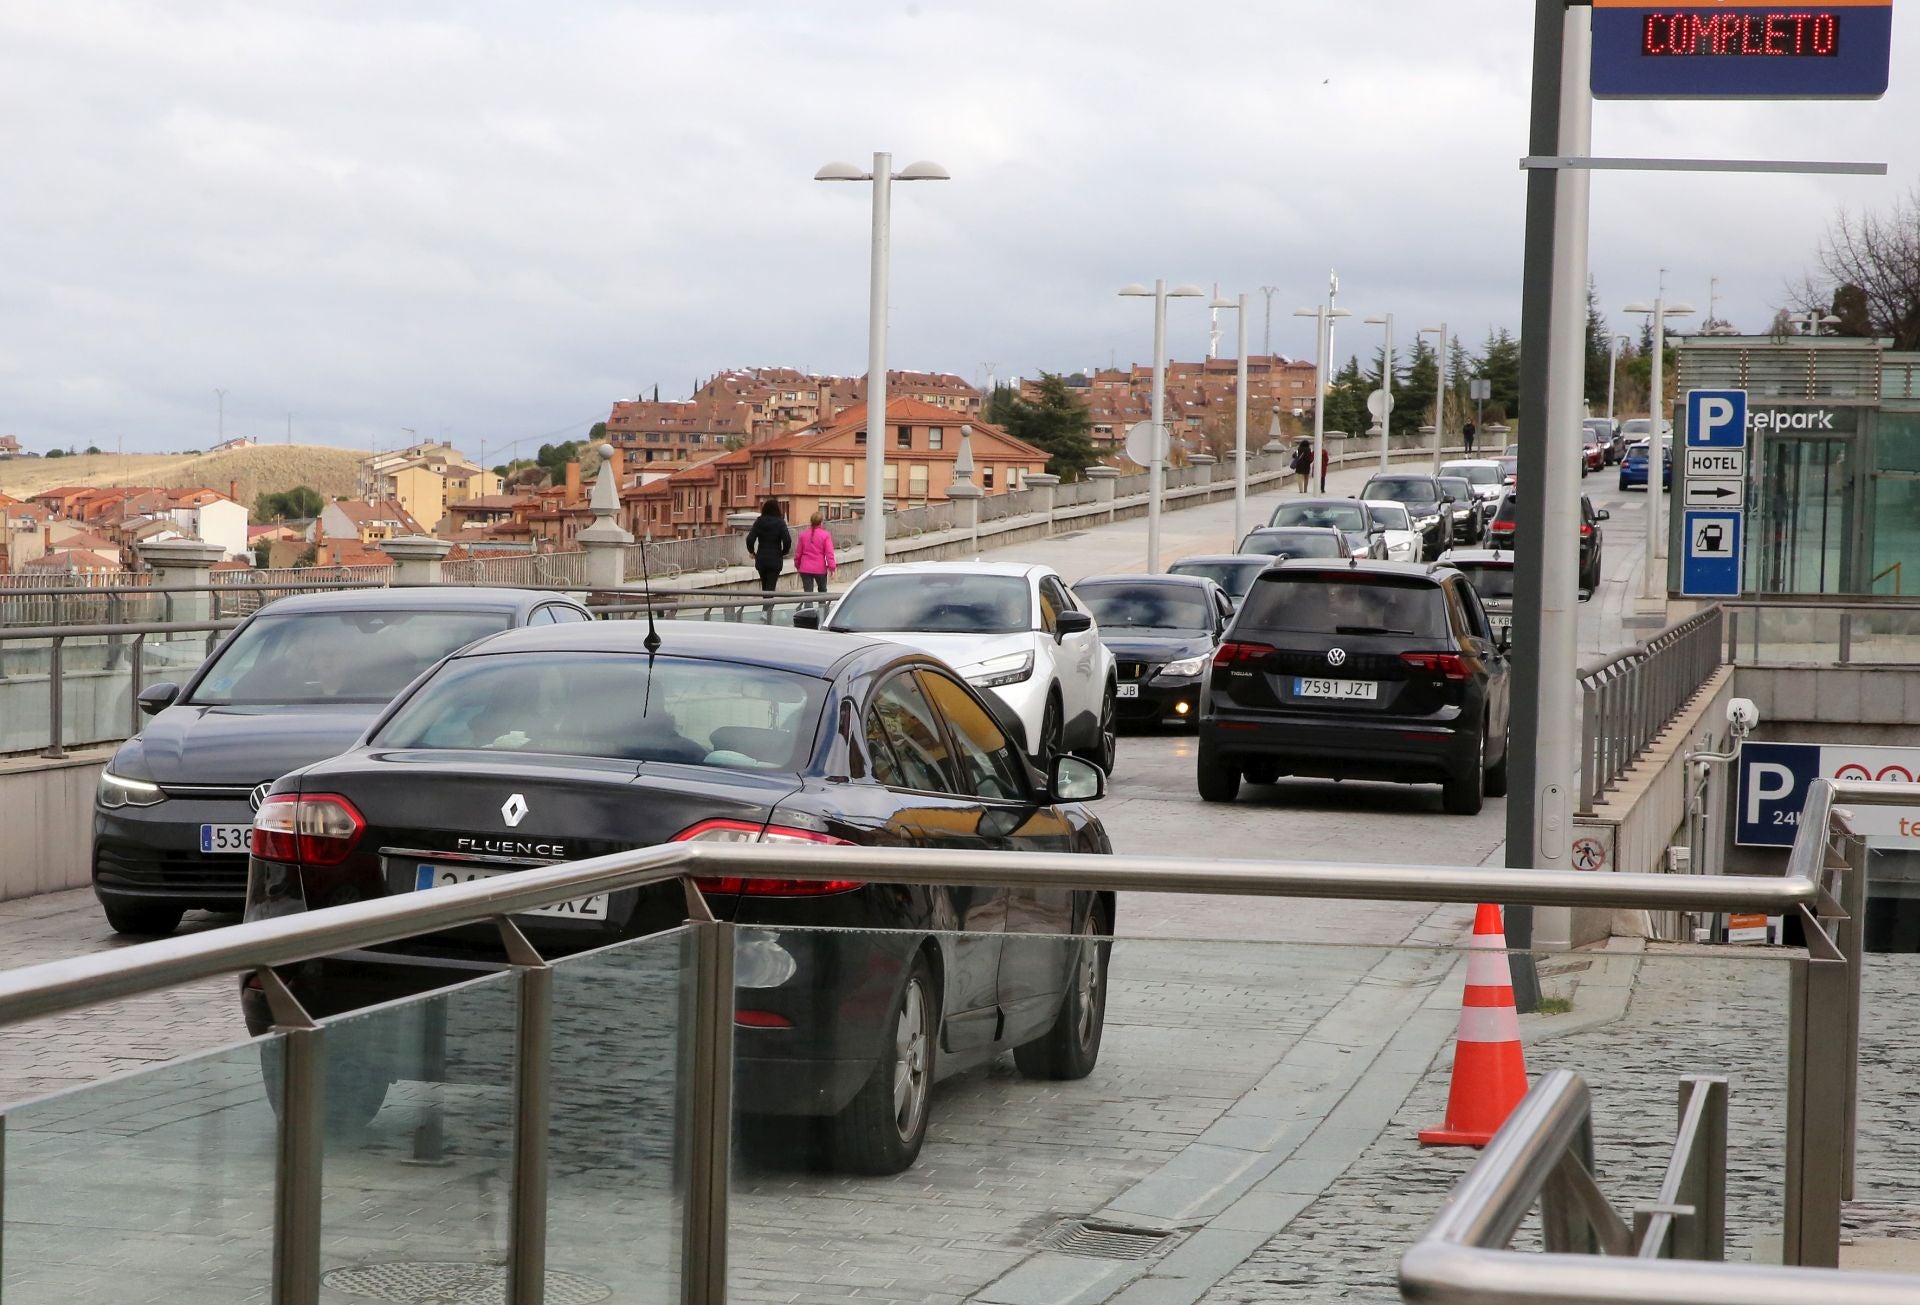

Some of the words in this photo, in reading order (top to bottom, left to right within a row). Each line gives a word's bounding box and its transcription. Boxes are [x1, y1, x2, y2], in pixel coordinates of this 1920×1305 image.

[1647, 14, 1833, 53] COMPLETO
[1699, 398, 1734, 441] P
[1746, 410, 1834, 433] telpark
[1692, 457, 1738, 470] HOTEL
[1304, 681, 1339, 694] 7591
[1345, 681, 1372, 696] JZT
[1747, 762, 1795, 824] P
[458, 838, 565, 857] FLUENCE
